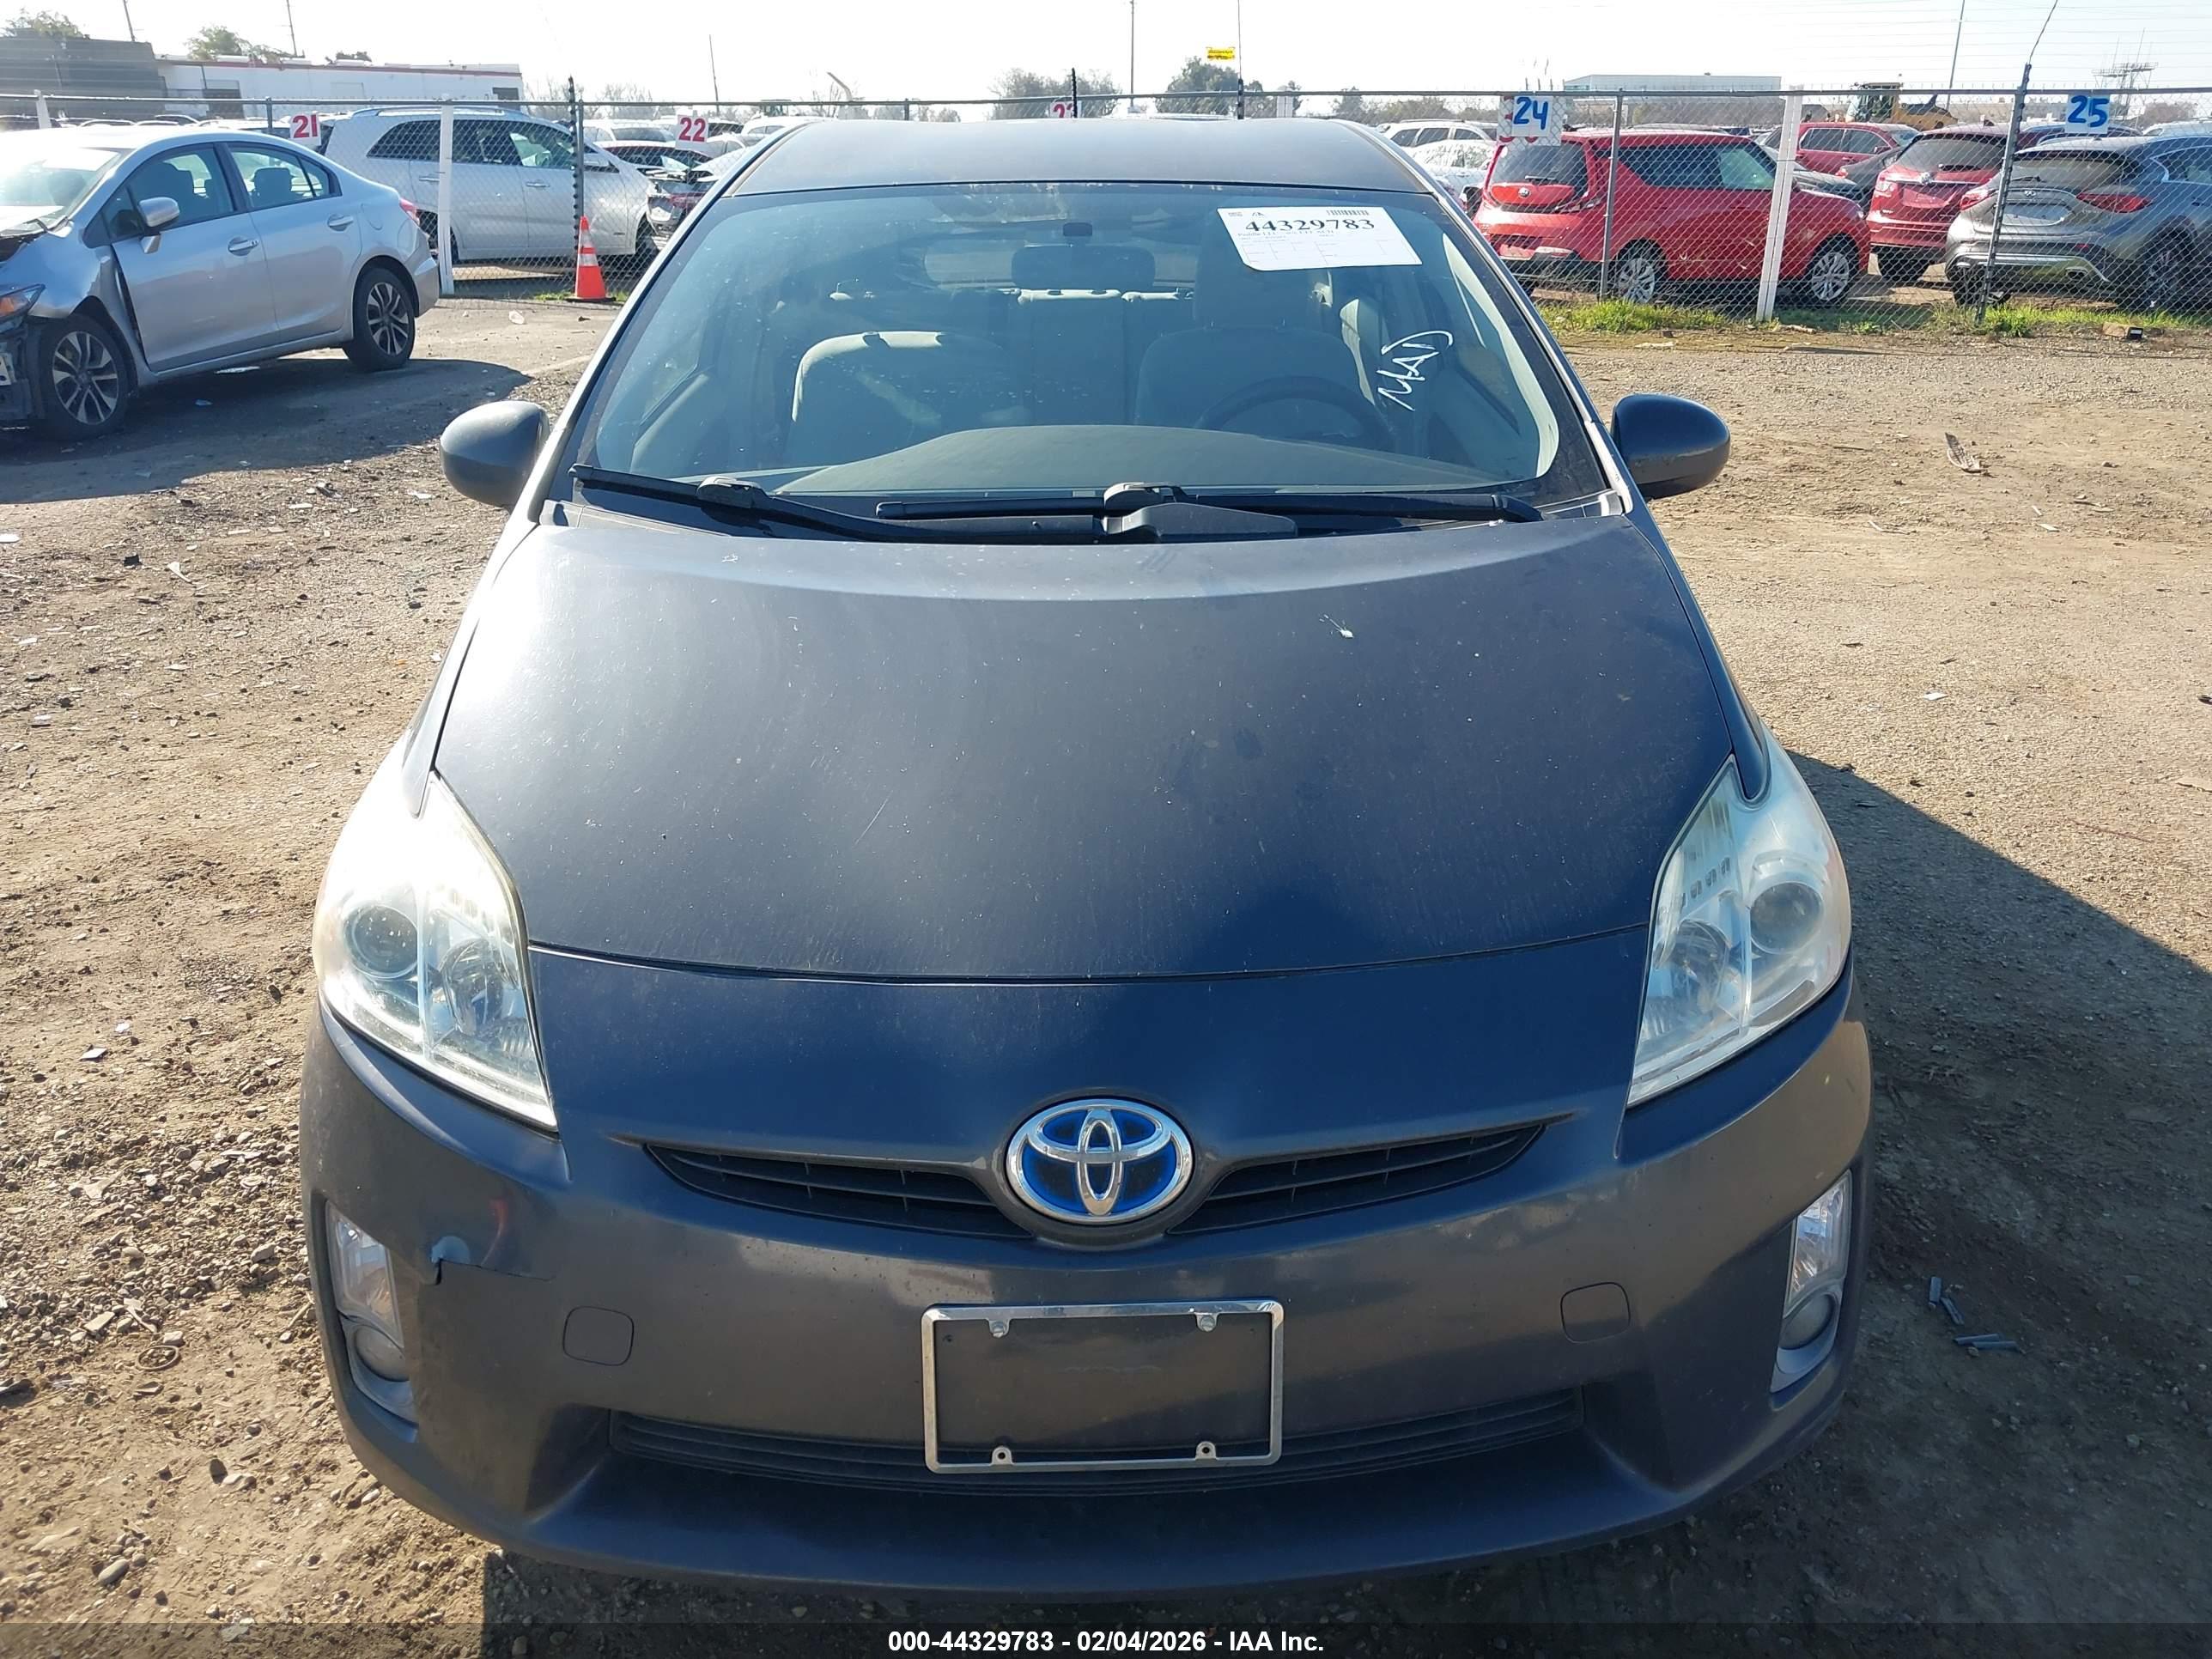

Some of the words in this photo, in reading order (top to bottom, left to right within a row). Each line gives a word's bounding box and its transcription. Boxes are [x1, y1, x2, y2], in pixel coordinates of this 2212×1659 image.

[1513, 96, 1548, 130] 24
[2068, 95, 2110, 127] 25
[293, 114, 318, 138] 21
[679, 117, 706, 142] 22
[1245, 219, 1375, 232] 44329783
